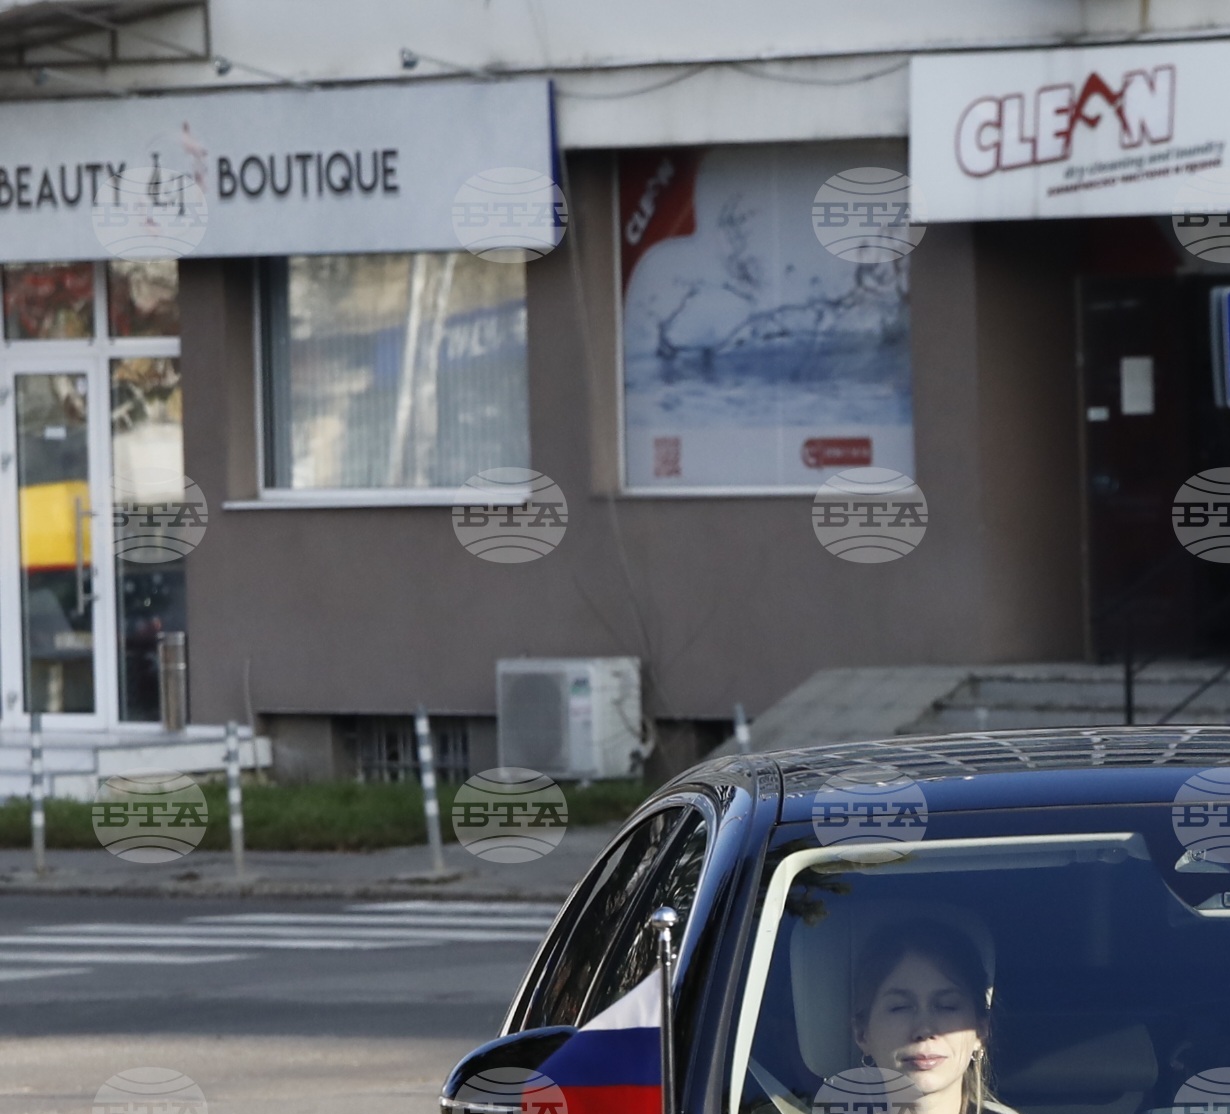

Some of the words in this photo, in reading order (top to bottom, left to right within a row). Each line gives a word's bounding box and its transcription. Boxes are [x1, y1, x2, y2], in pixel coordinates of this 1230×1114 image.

[954, 63, 1177, 179] CLEAN
[0, 160, 127, 209] BEAUTY
[217, 148, 400, 200] BOUTIQUE
